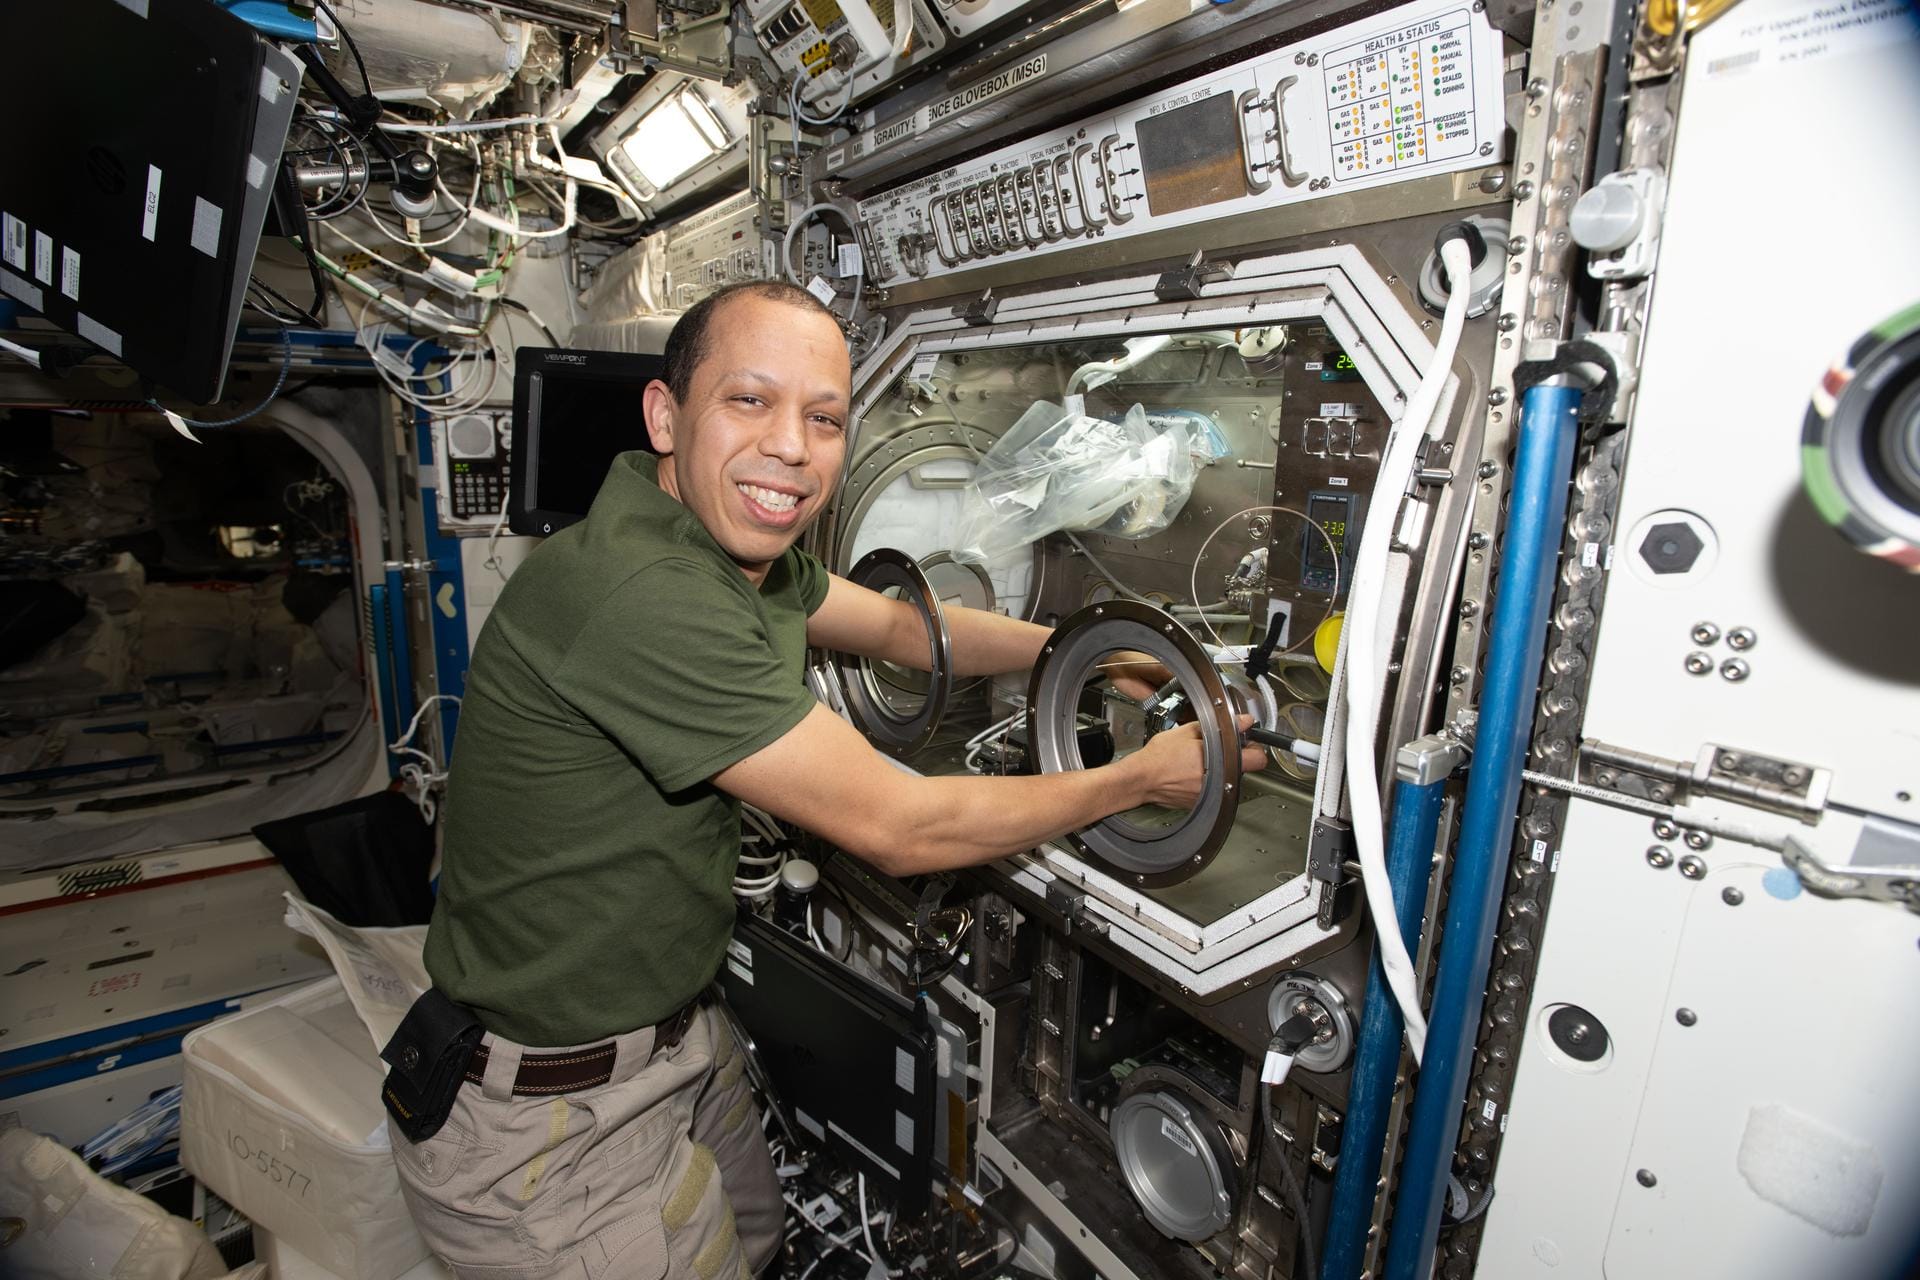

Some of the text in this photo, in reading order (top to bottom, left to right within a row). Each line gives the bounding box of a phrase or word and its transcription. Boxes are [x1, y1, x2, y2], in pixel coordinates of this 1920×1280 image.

[1813, 5, 1847, 20] Rack
[1365, 21, 1441, 53] HEALTH & STATUS
[1440, 32, 1453, 40] MODE
[1440, 39, 1461, 50] NORMAL
[1440, 51, 1463, 61] MANUAL
[1366, 64, 1377, 73] GAS
[1441, 63, 1456, 73] OPEN
[952, 74, 1009, 110] GLOVEBOX
[1011, 55, 1046, 84] (MSG)
[1442, 72, 1463, 84] SEALED
[1442, 84, 1465, 95] DONNING
[1149, 87, 1212, 115] INFO & CONTROL CENTRE
[1369, 102, 1380, 110] GAS
[1341, 110, 1350, 118] GAS
[1433, 111, 1466, 124] PROCESSORS
[1445, 119, 1467, 129] RUNNING
[1445, 129, 1469, 140] STOPPED
[1373, 138, 1383, 146] GAS
[1404, 140, 1416, 148] DOOR
[1030, 143, 1066, 160] SPECIAL FUNCTIONS
[1344, 145, 1354, 153] GAS
[1344, 155, 1355, 163] HUM
[860, 194, 884, 209] COMMAND
[884, 191, 894, 203] AND
[893, 181, 925, 198] MONITORING
[925, 174, 942, 187] PANEL
[942, 168, 958, 180] (CMP)
[543, 353, 588, 362] VIEWPOINT
